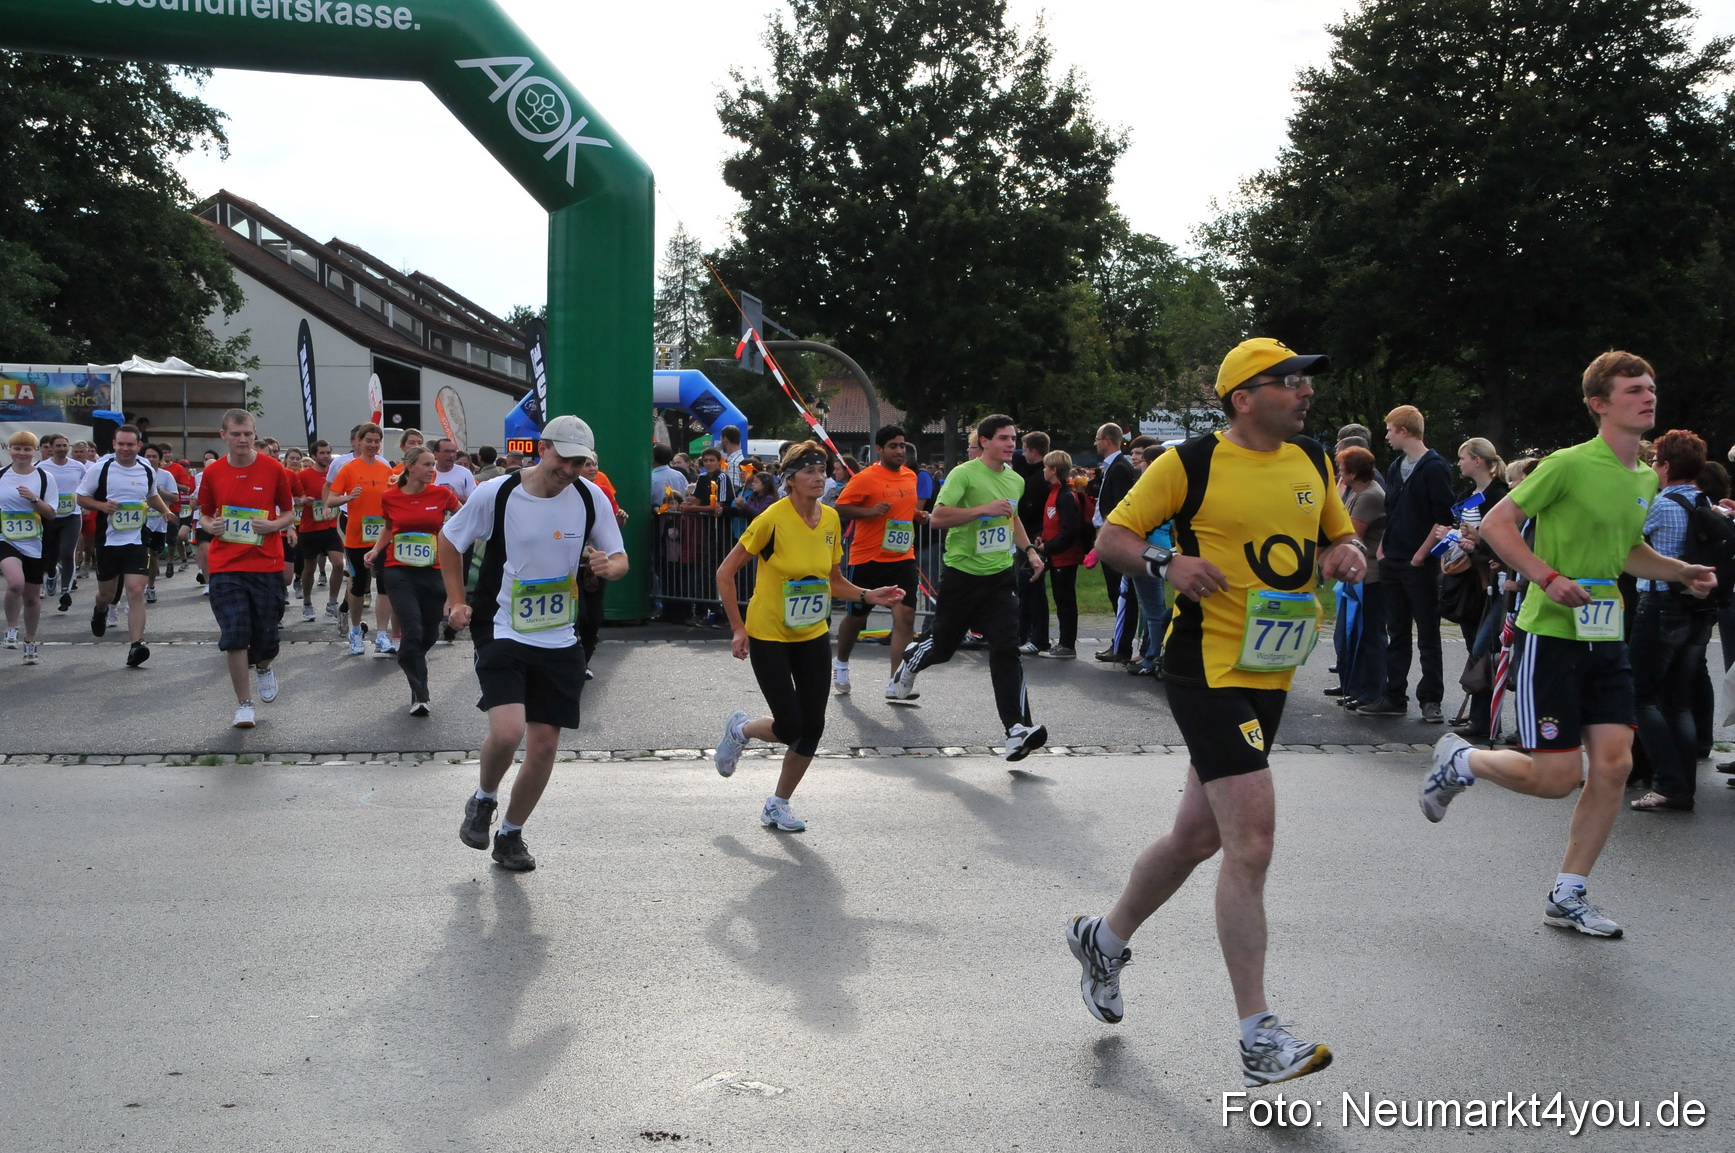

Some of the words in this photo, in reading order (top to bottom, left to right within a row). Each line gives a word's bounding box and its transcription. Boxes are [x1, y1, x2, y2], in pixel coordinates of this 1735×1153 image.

[91, 0, 421, 30] undheitskasse.
[454, 56, 613, 188] AOK
[1296, 491, 1313, 504] FC
[115, 511, 140, 523] 314
[6, 520, 34, 533] 313
[224, 519, 256, 535] 114
[887, 530, 910, 544] 589
[979, 527, 1006, 546] 378
[396, 543, 431, 558] 1156
[519, 593, 564, 619] 318
[789, 595, 824, 617] 775
[1579, 600, 1615, 625] 377
[1254, 619, 1306, 651] 771
[1248, 728, 1262, 743] FC
